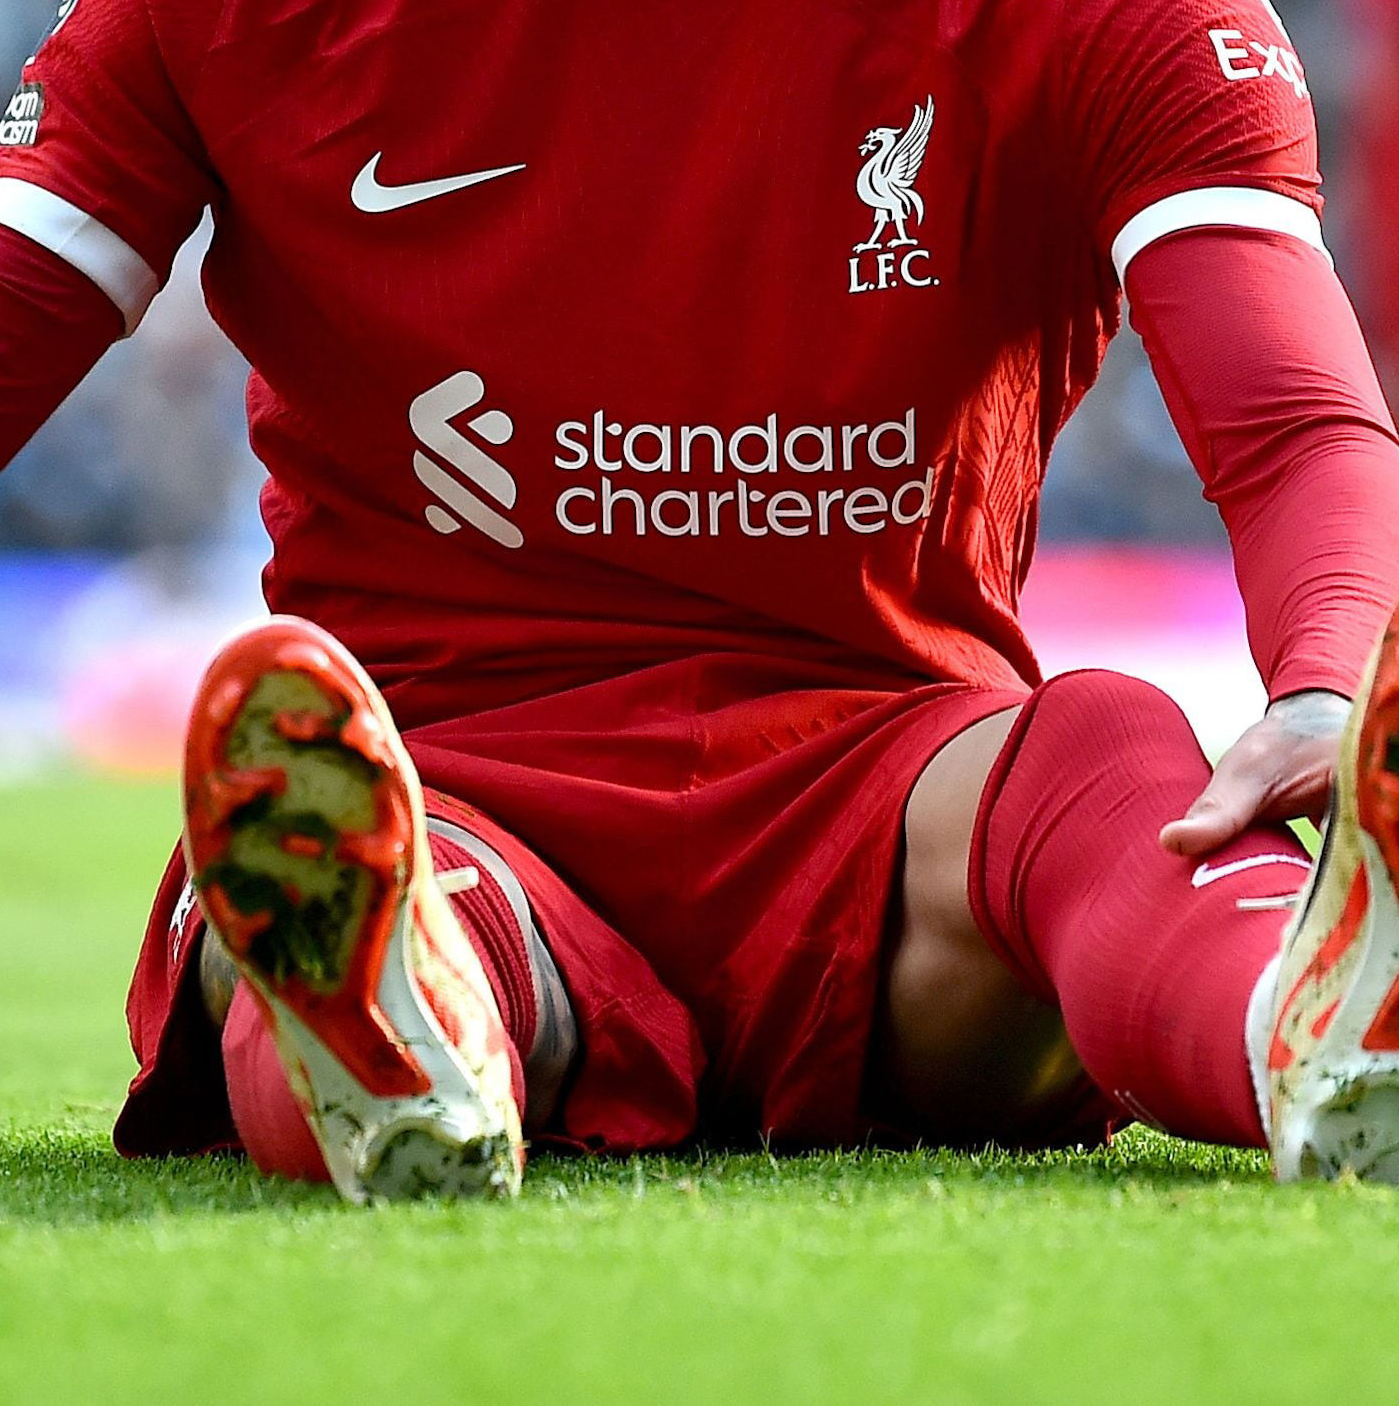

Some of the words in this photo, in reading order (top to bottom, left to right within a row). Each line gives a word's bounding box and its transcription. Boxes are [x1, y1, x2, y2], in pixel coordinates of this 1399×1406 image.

[848, 249, 940, 293] L.F.C.
[554, 407, 915, 473] standard
[555, 466, 935, 536] chartered
